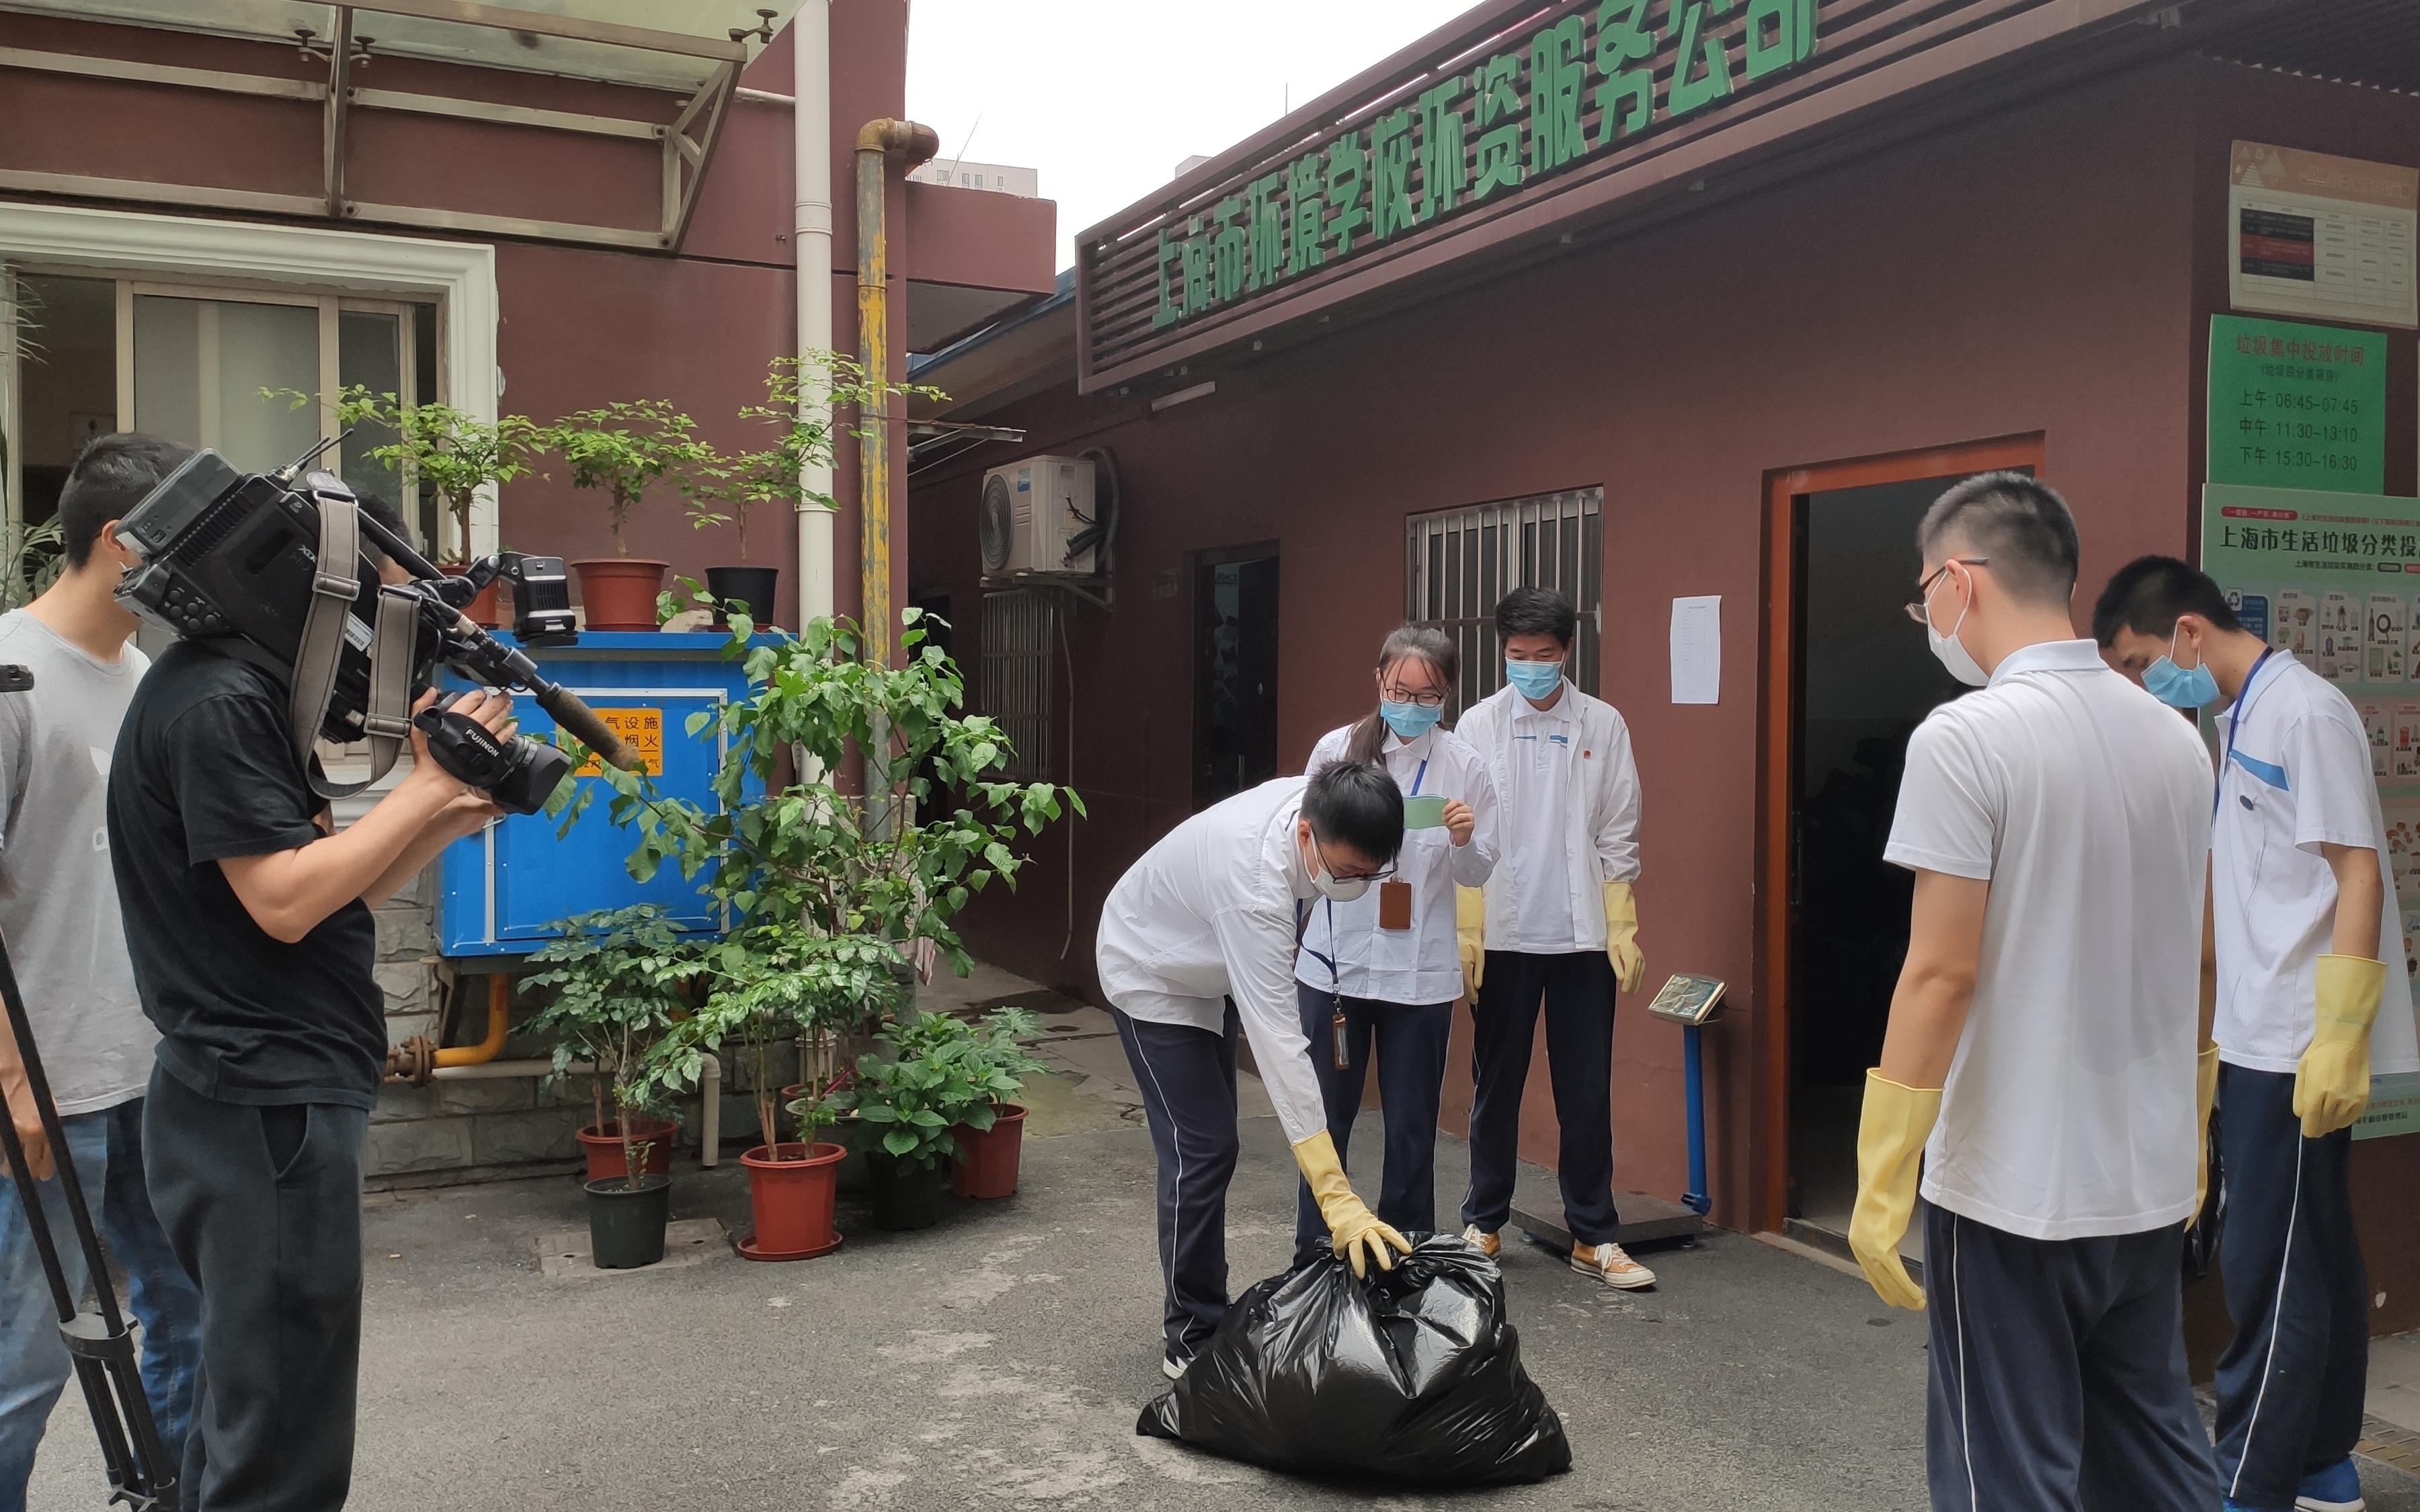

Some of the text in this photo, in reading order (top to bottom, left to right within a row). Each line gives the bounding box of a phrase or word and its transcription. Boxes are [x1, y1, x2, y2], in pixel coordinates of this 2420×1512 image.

[2236, 334, 2364, 366] 垃圾集中投放时间
[2220, 526, 2420, 557] 上海市生活垃圾分类投
[604, 716, 659, 730] 气设施
[465, 728, 499, 757] FUJINON
[624, 734, 659, 748] 烟火
